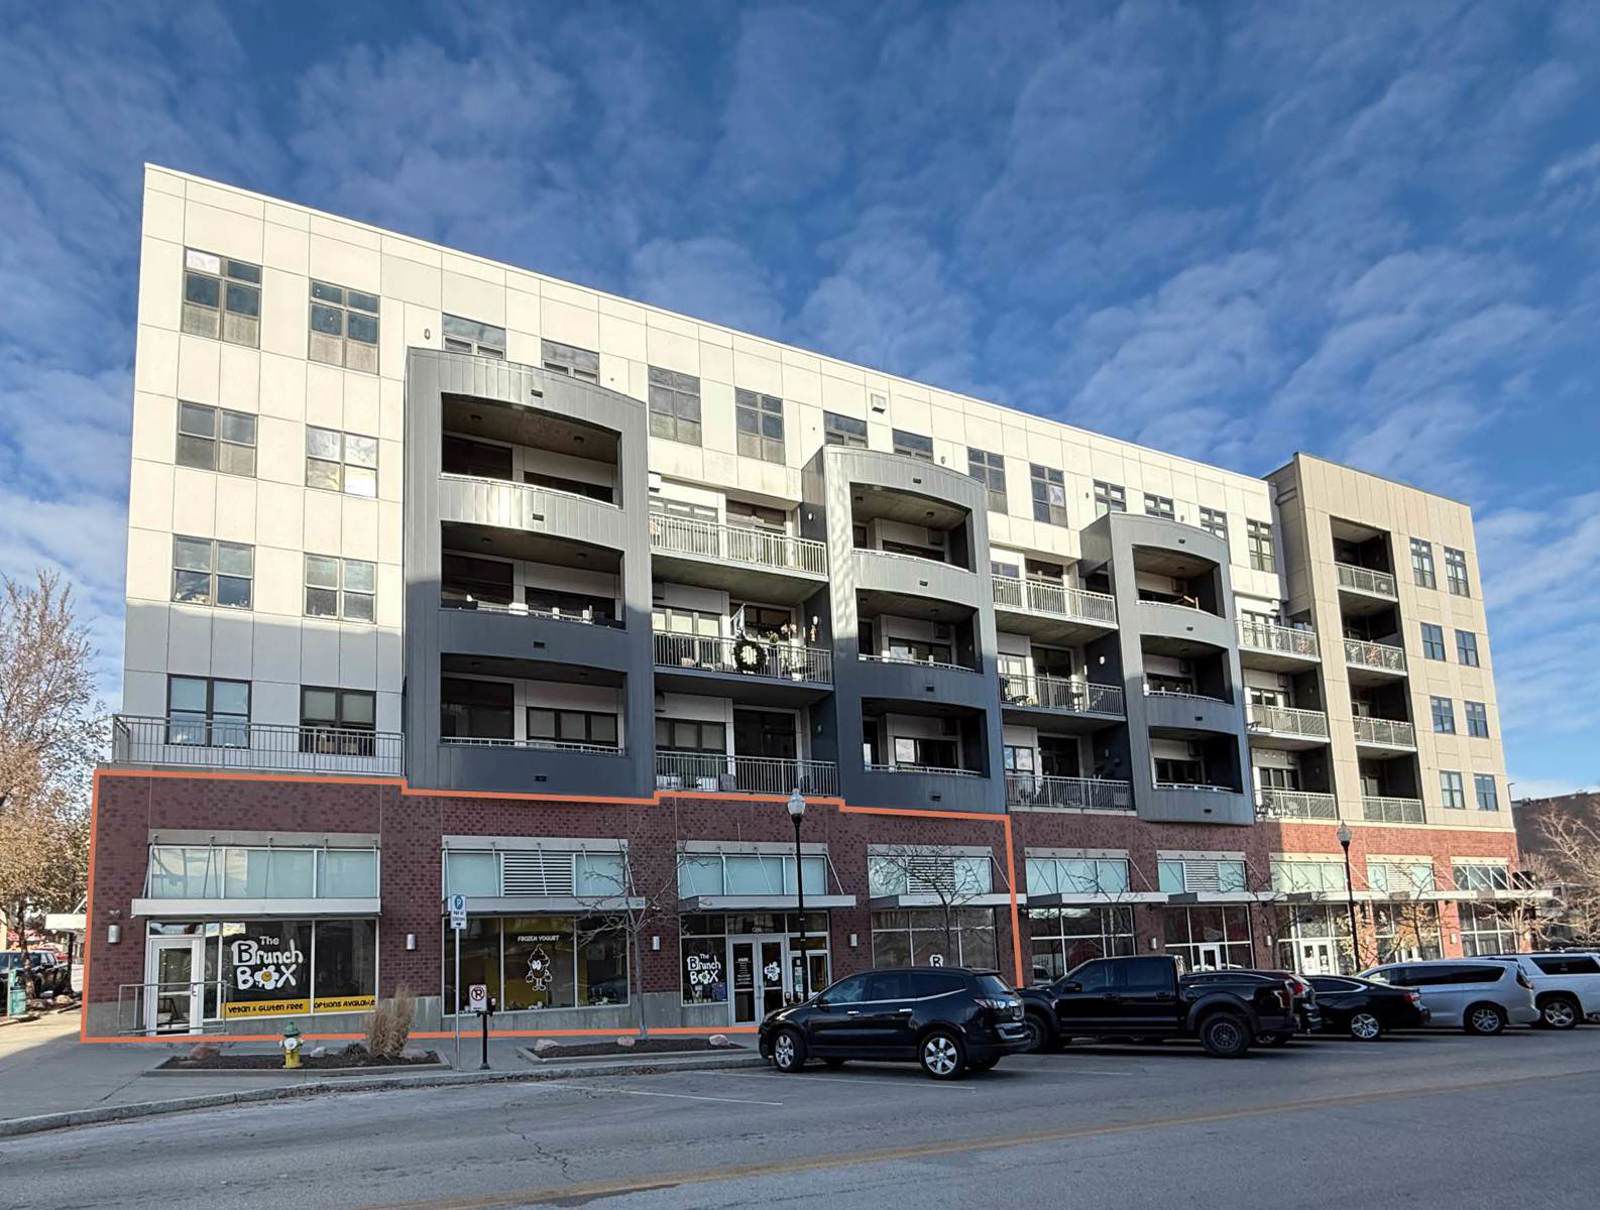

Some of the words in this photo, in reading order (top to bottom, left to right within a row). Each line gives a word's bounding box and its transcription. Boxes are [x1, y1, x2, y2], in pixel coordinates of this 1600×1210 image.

[259, 936, 280, 946] The
[231, 939, 304, 966] Brunch
[687, 955, 722, 971] Brunch
